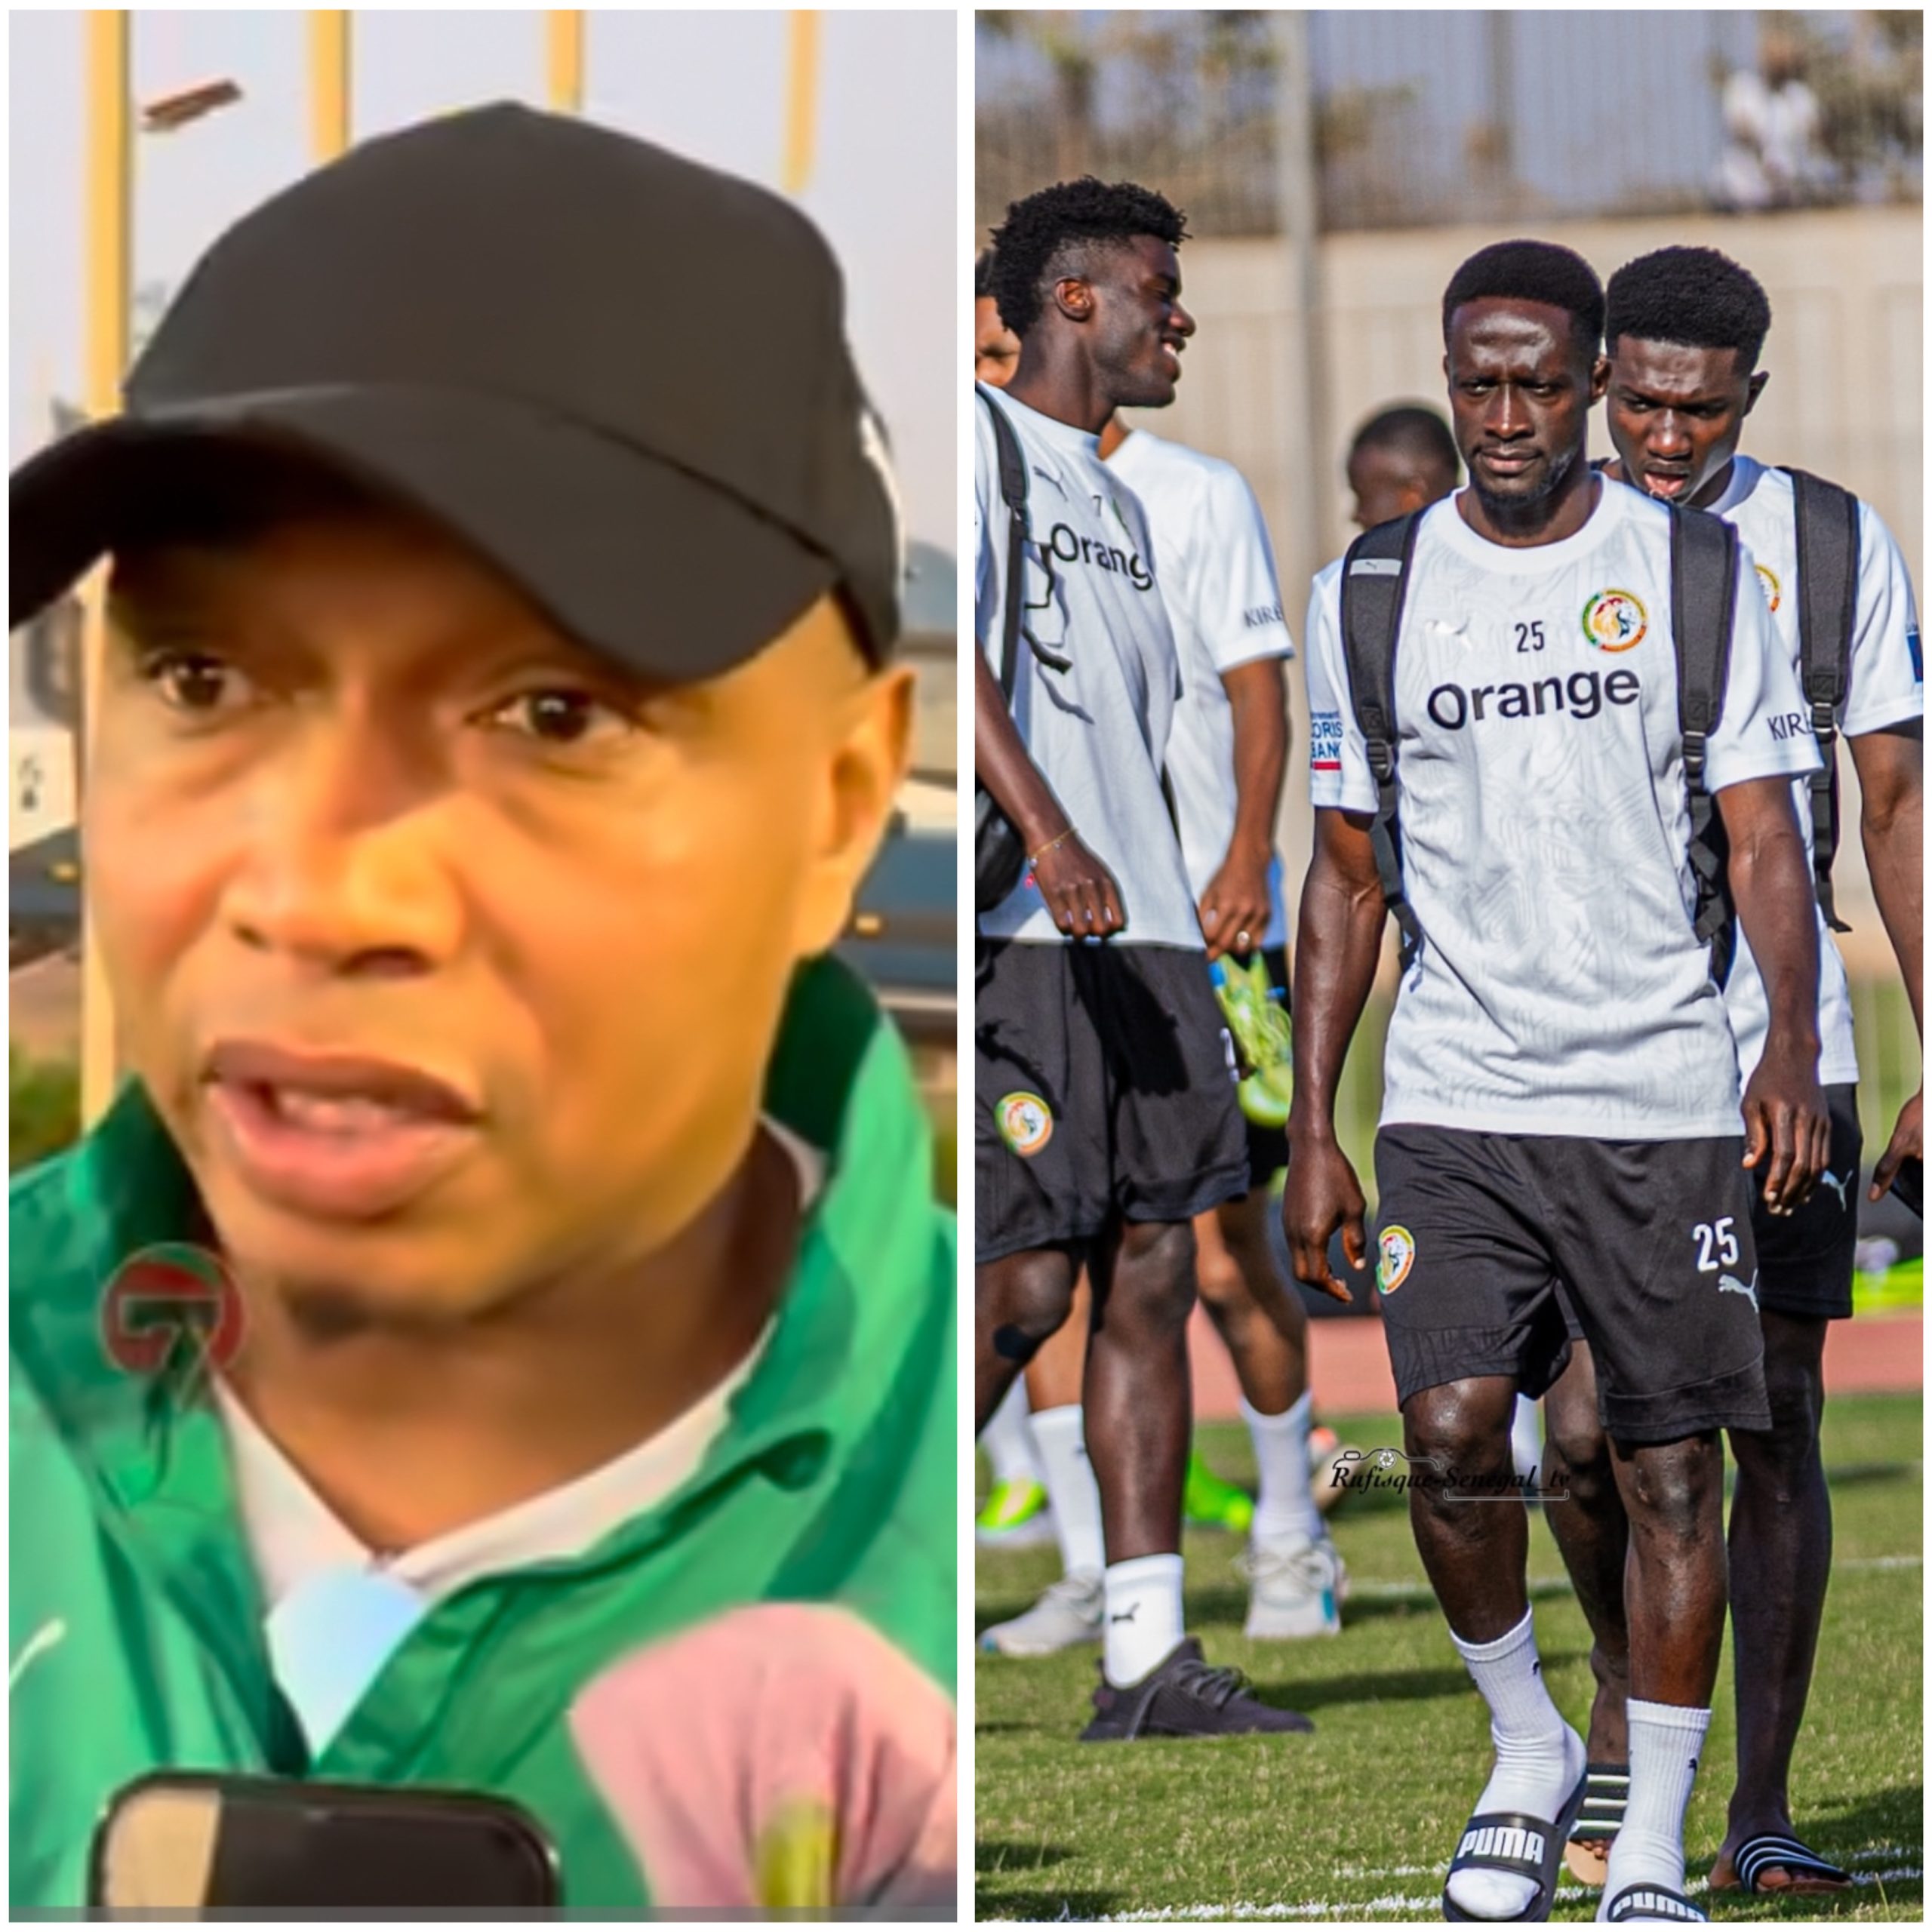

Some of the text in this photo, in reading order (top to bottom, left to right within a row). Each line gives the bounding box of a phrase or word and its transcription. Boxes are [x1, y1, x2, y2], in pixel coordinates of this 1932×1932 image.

[1515, 620, 1546, 653] 25
[1427, 669, 1640, 731] Orange
[1311, 721, 1343, 739] ORIS
[1693, 1217, 1739, 1272] 25
[1457, 1826, 1546, 1865] PUMA
